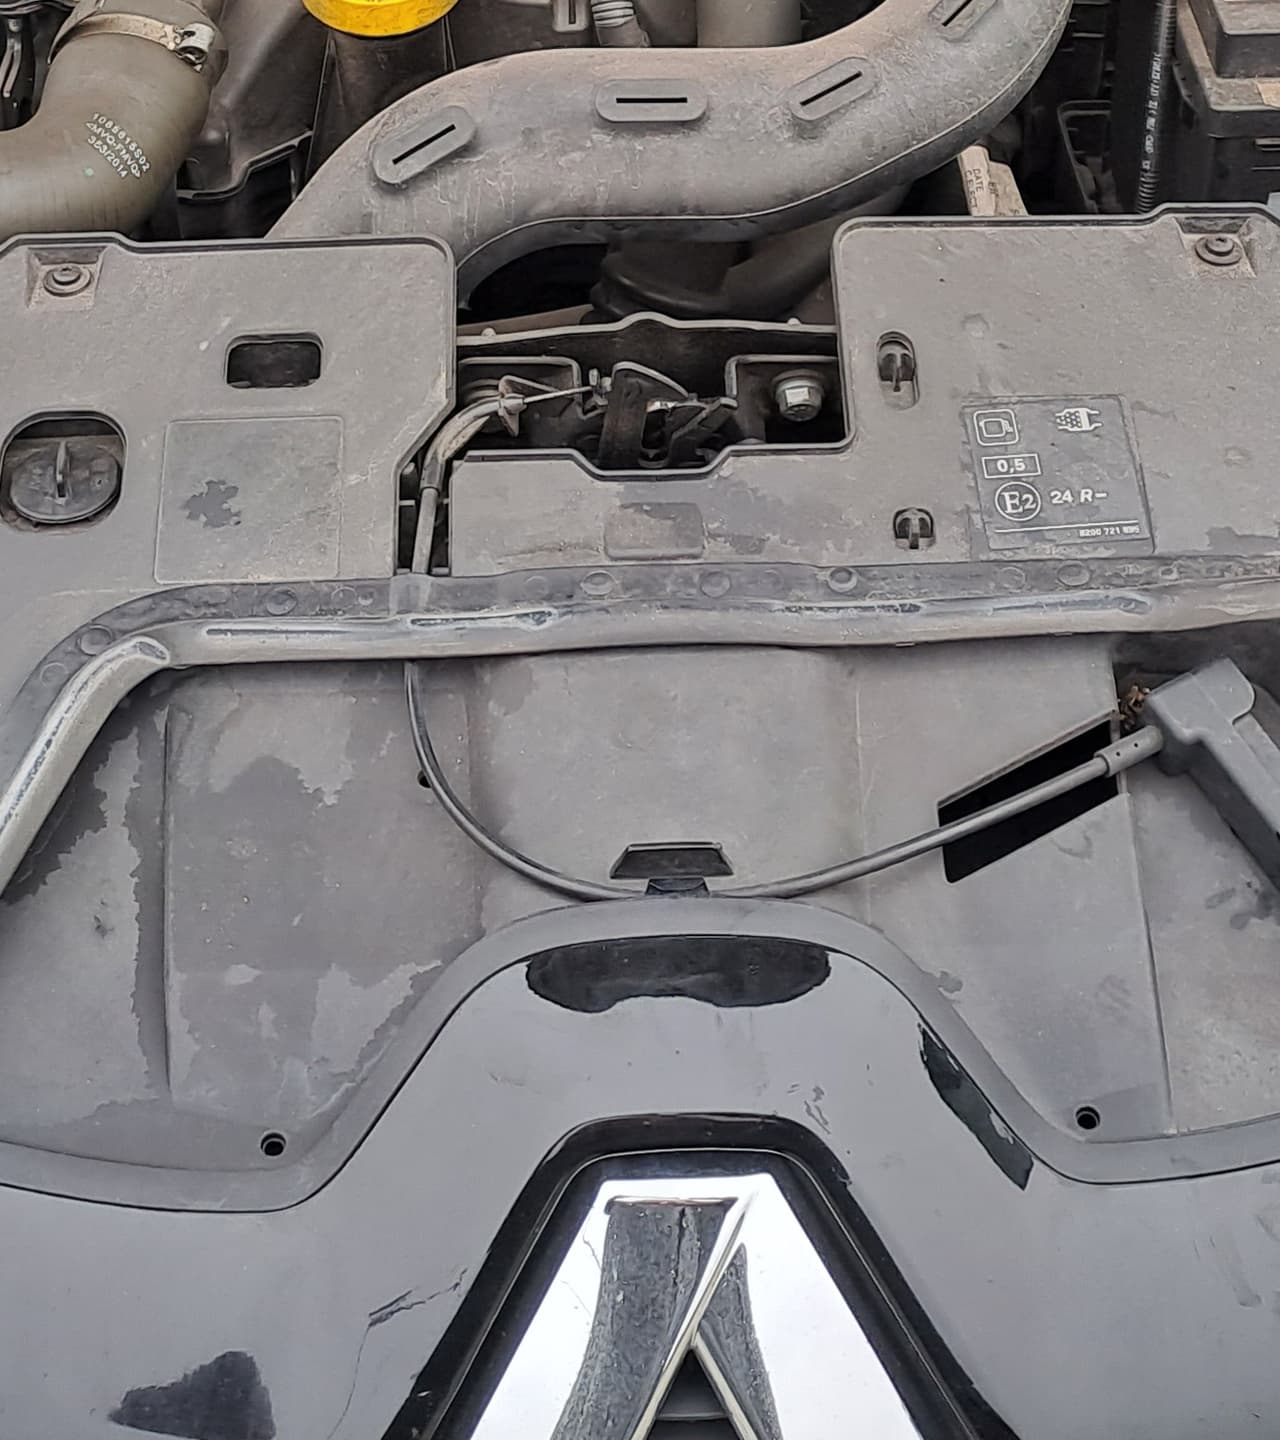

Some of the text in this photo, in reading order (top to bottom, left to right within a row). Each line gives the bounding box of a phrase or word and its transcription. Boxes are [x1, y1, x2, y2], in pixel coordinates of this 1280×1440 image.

[997, 458, 1026, 474] 0,5
[1002, 491, 1037, 514] E2
[1050, 489, 1074, 504] 24
[1104, 526, 1121, 536] 721
